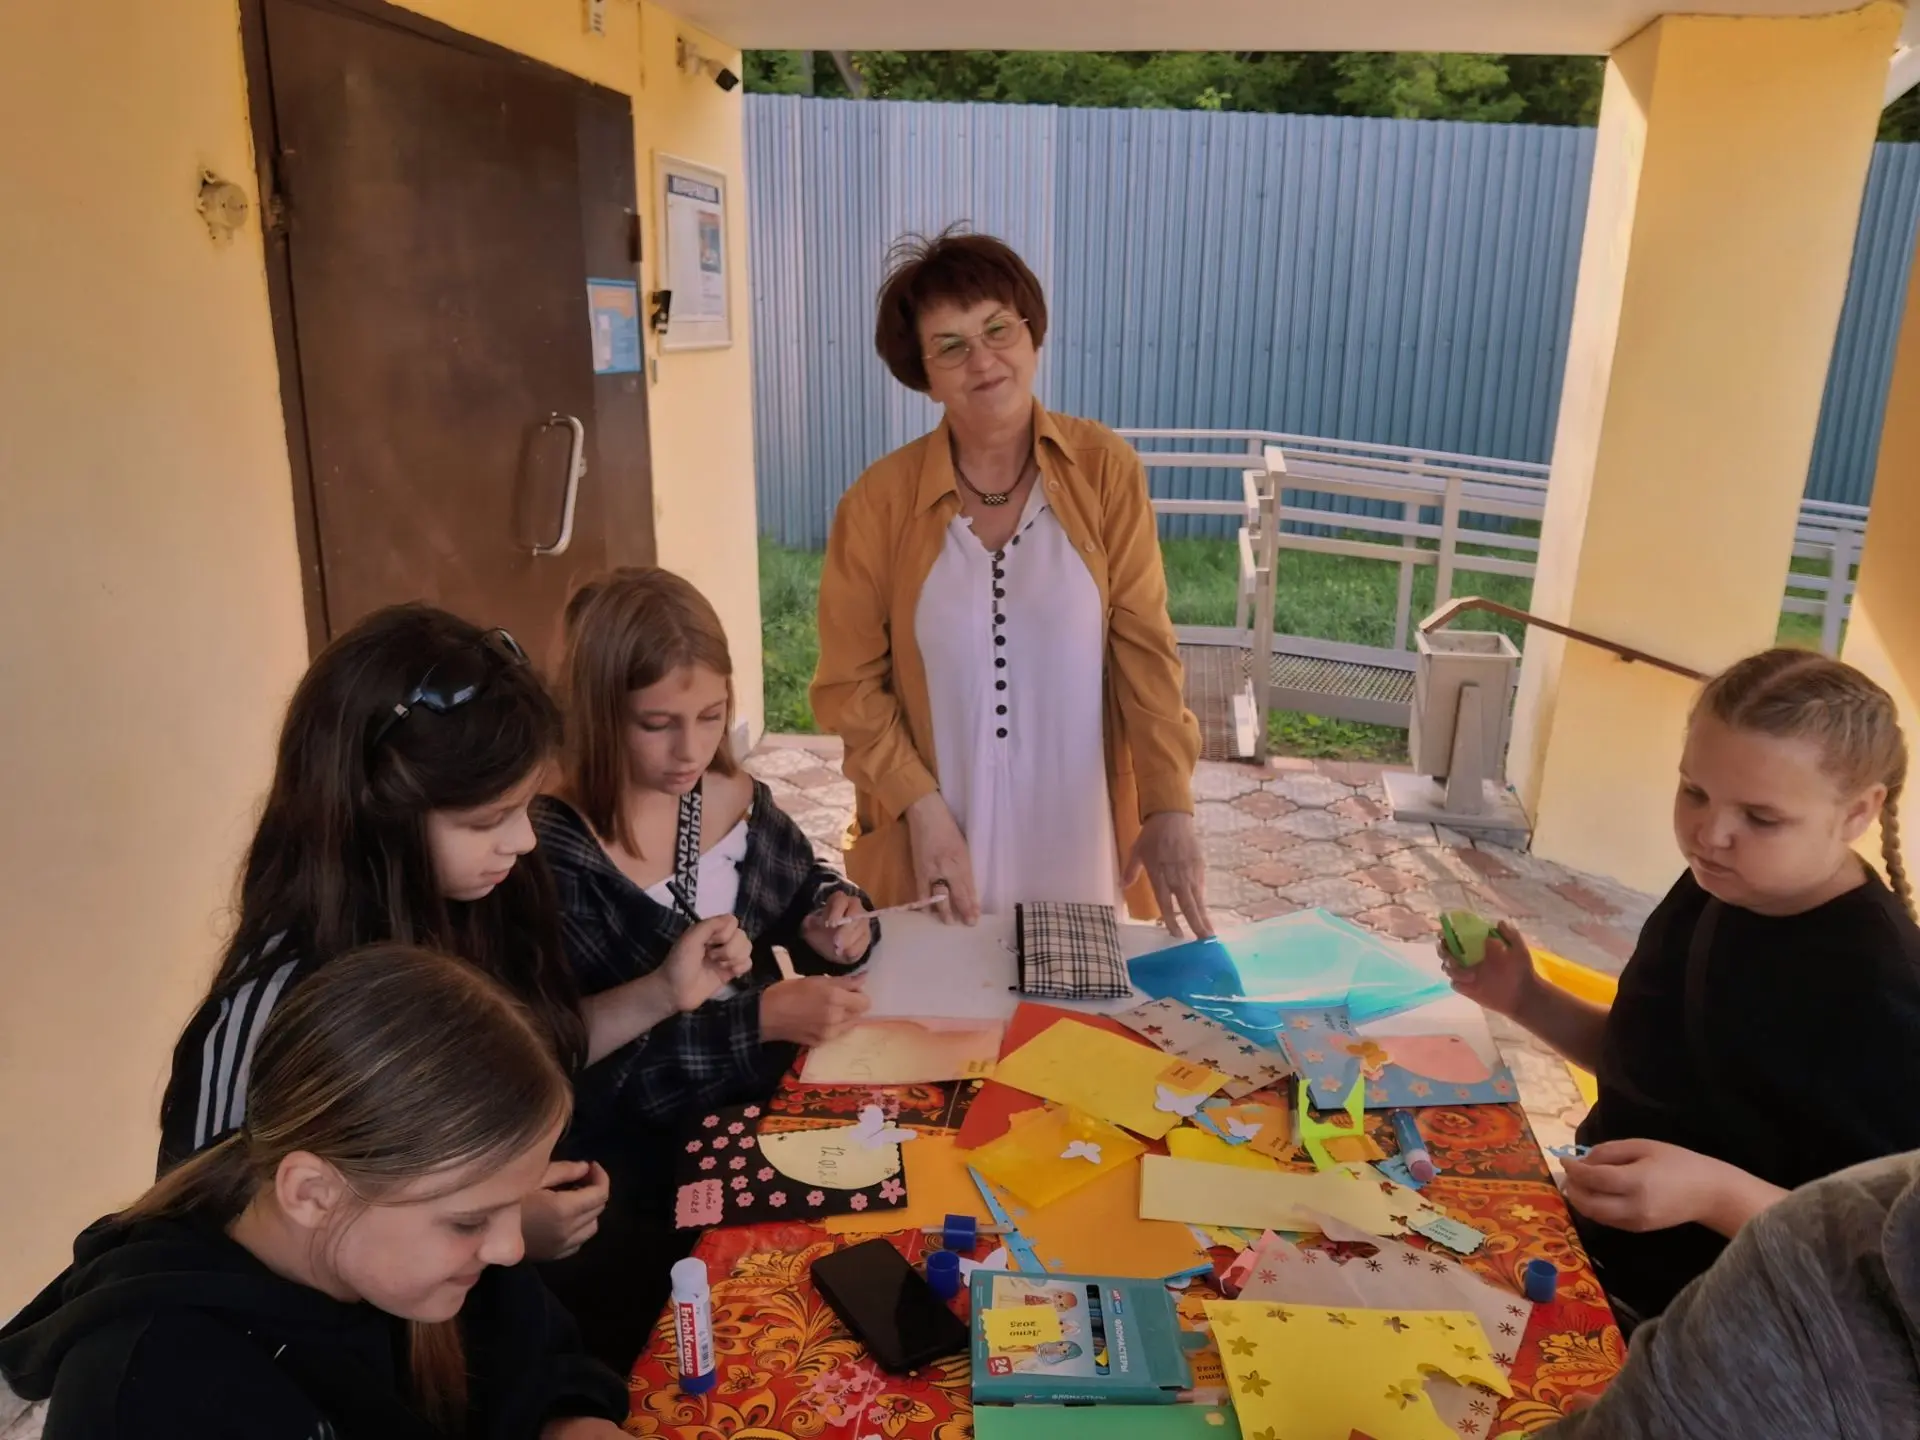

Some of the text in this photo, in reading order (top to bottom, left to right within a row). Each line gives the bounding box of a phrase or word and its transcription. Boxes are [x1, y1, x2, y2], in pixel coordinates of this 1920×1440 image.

[680, 1307, 694, 1374] ErichKrause
[994, 1359, 1009, 1373] 24
[1115, 1318, 1129, 1373] ФЛОМАСТЕРЫ
